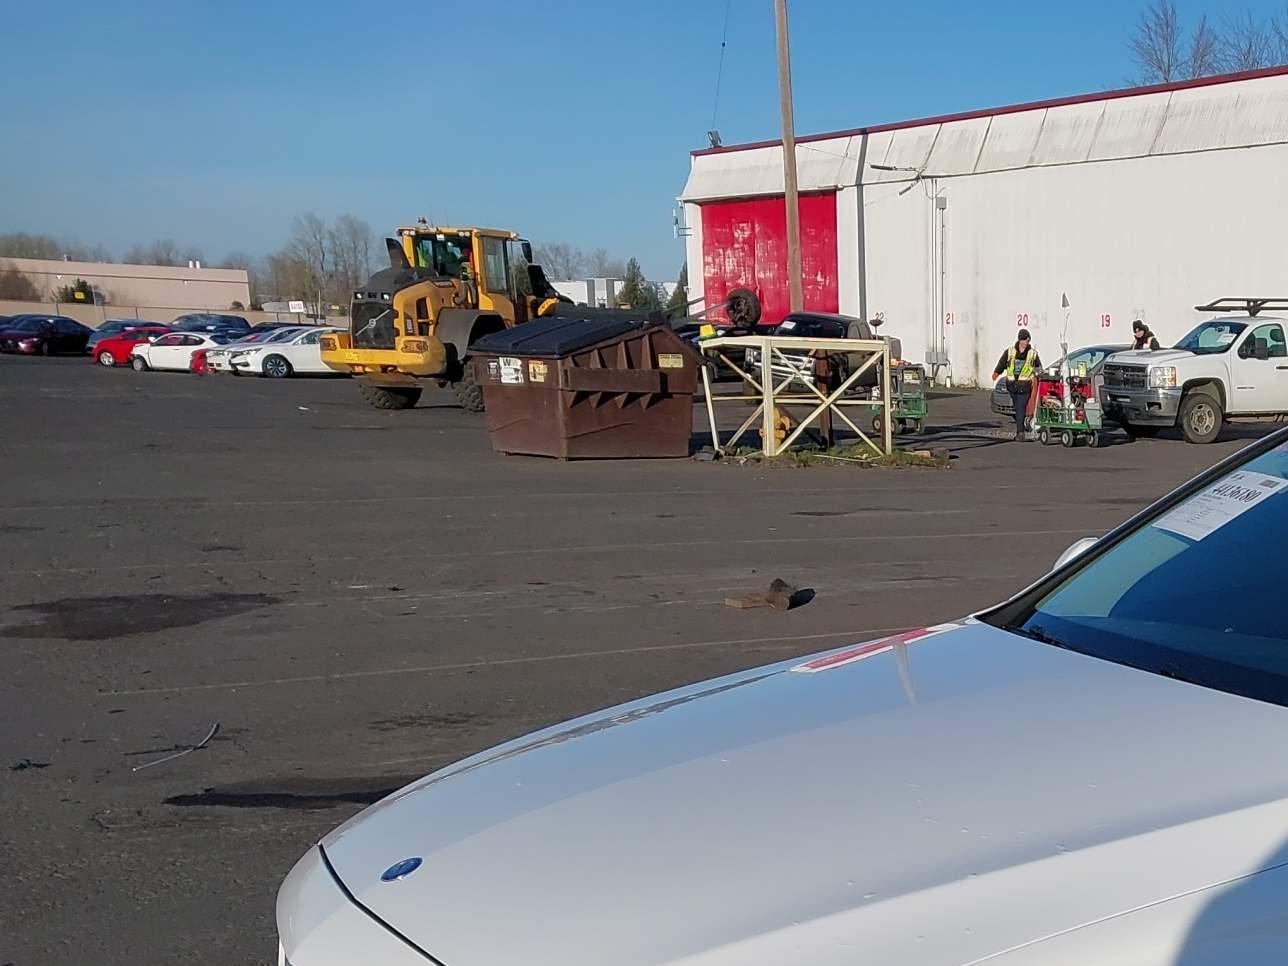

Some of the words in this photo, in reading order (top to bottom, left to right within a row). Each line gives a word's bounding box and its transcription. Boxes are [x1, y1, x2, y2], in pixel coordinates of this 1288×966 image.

[945, 312, 955, 326] 21
[1016, 313, 1029, 327] 20
[1100, 313, 1111, 328] 19
